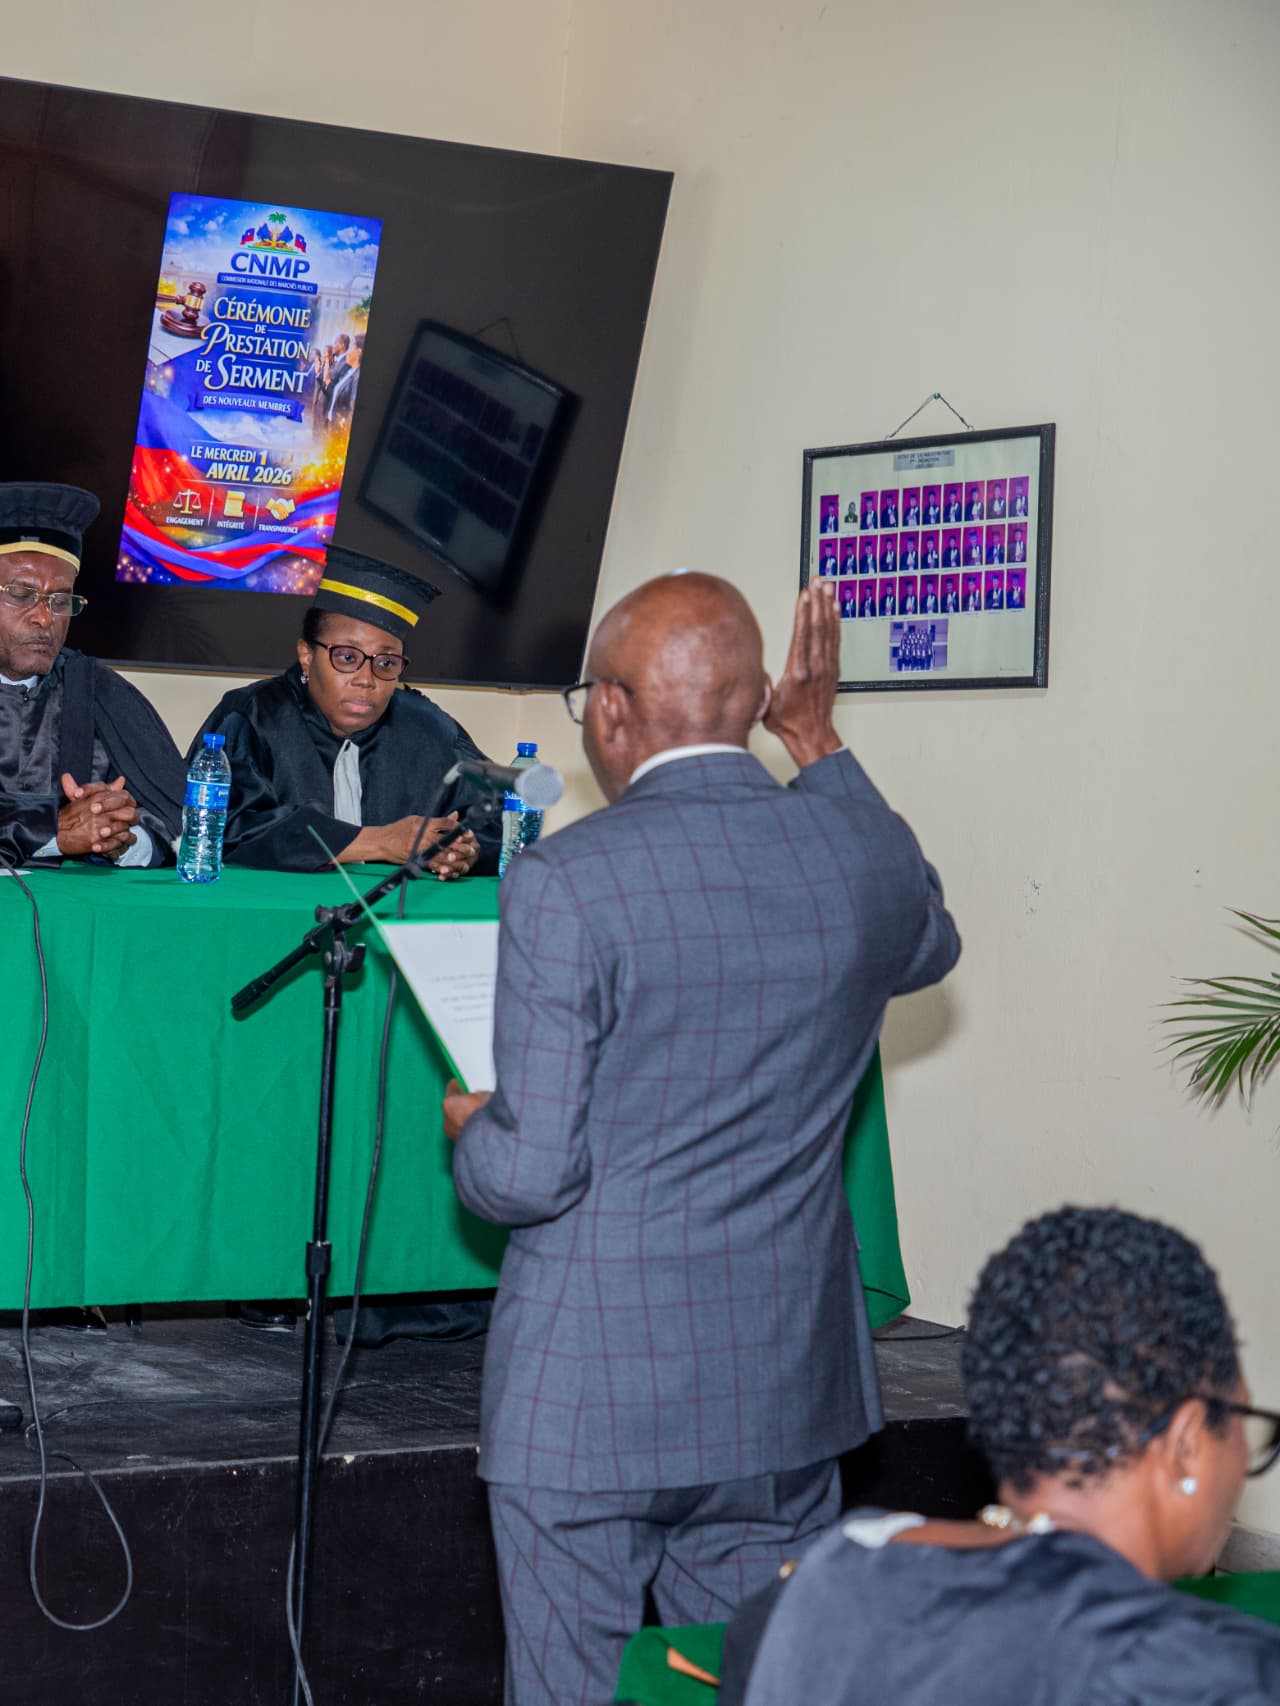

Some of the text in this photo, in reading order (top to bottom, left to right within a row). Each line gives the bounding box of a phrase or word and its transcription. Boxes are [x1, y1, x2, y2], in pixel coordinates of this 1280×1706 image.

[231, 251, 310, 279] CNMP
[214, 296, 311, 328] CÉRÉMONIE
[254, 324, 267, 334] DE
[200, 322, 310, 360] PRESTATION
[196, 354, 308, 393] DE SERMENT
[203, 395, 291, 413] DES NOUVEAUX MEMBRES
[191, 445, 268, 466] LE MERCREDI 1
[206, 462, 293, 485] AVRIL 2026
[166, 516, 204, 526] ENGAGEMENT
[258, 523, 299, 534] TRANSPARENCE
